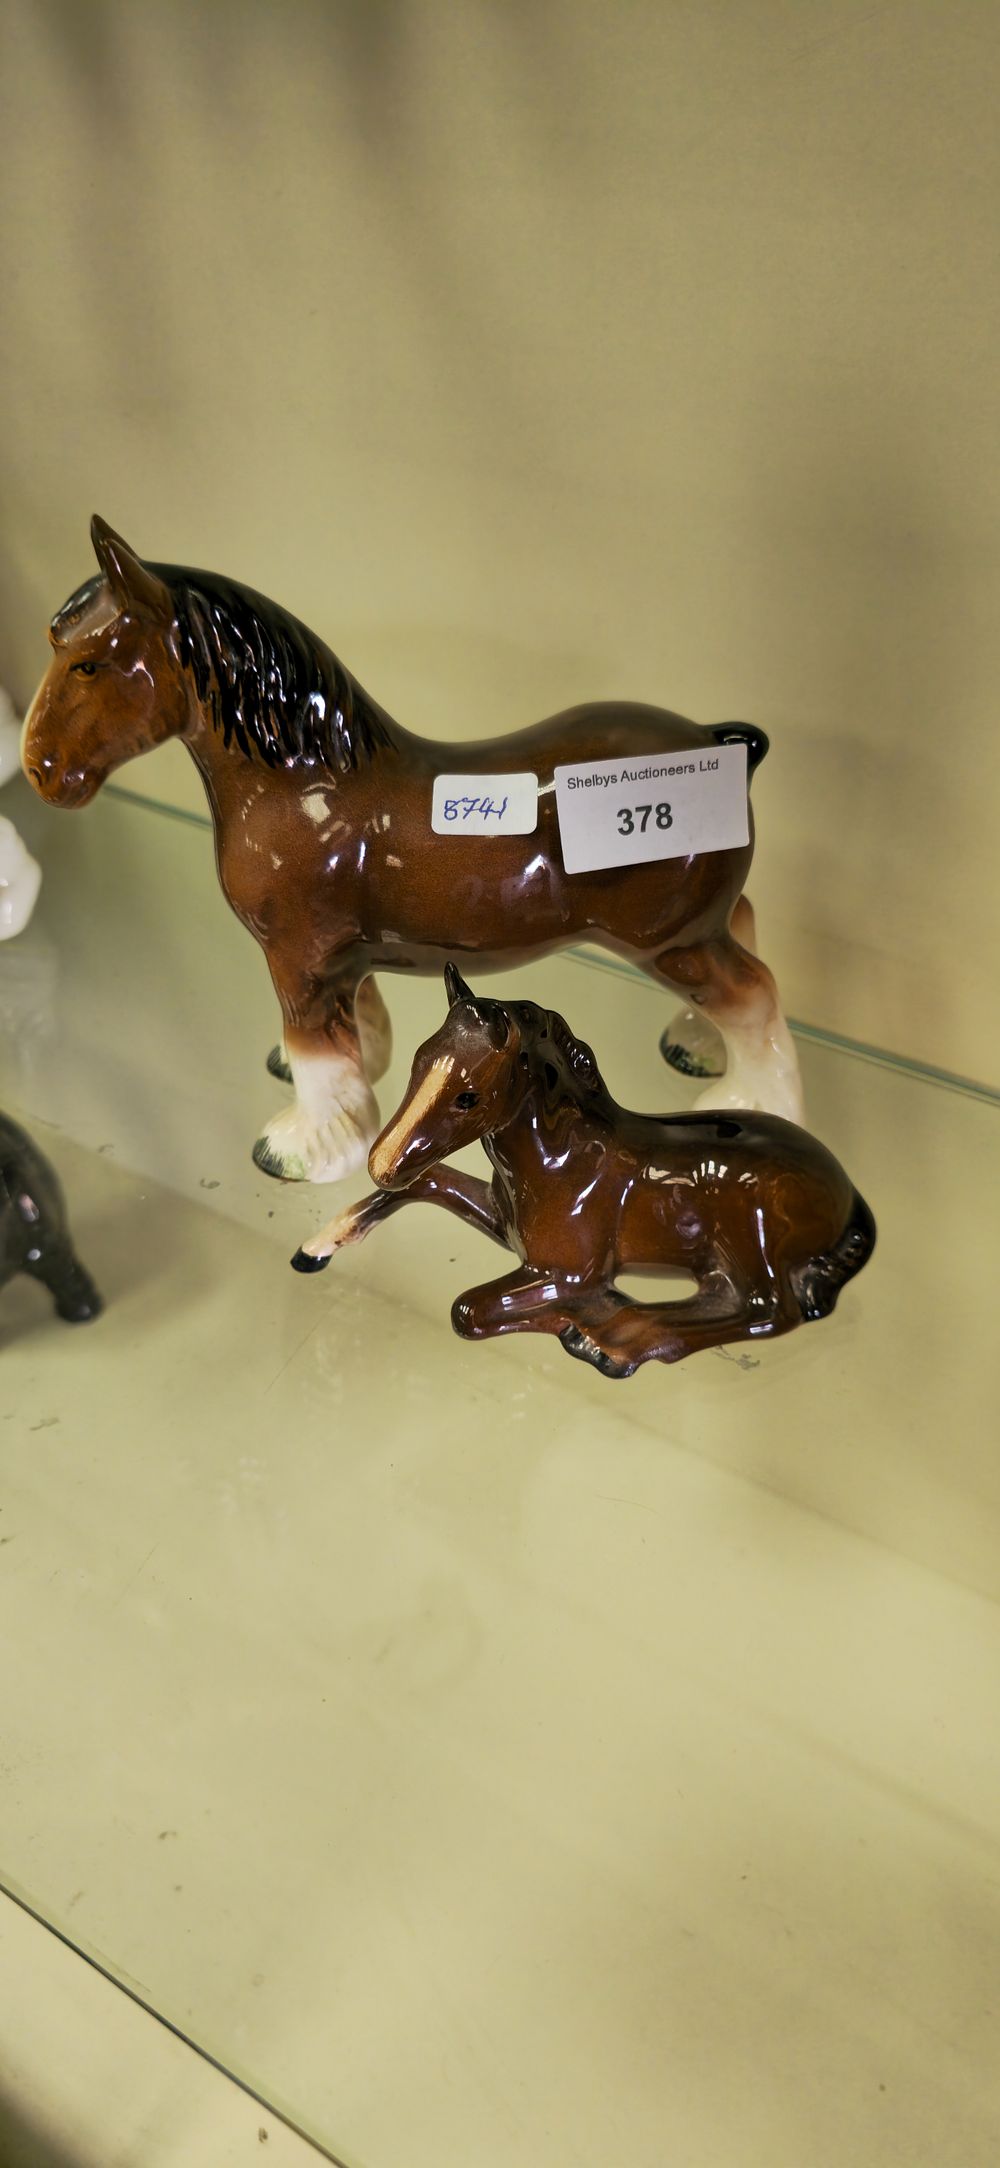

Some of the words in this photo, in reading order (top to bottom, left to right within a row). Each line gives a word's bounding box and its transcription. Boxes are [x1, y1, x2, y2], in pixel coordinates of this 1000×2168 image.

[567, 773, 617, 790] Shelbys
[620, 762, 695, 783] Auctioneers
[699, 759, 719, 772] Ltd
[616, 803, 673, 836] 378
